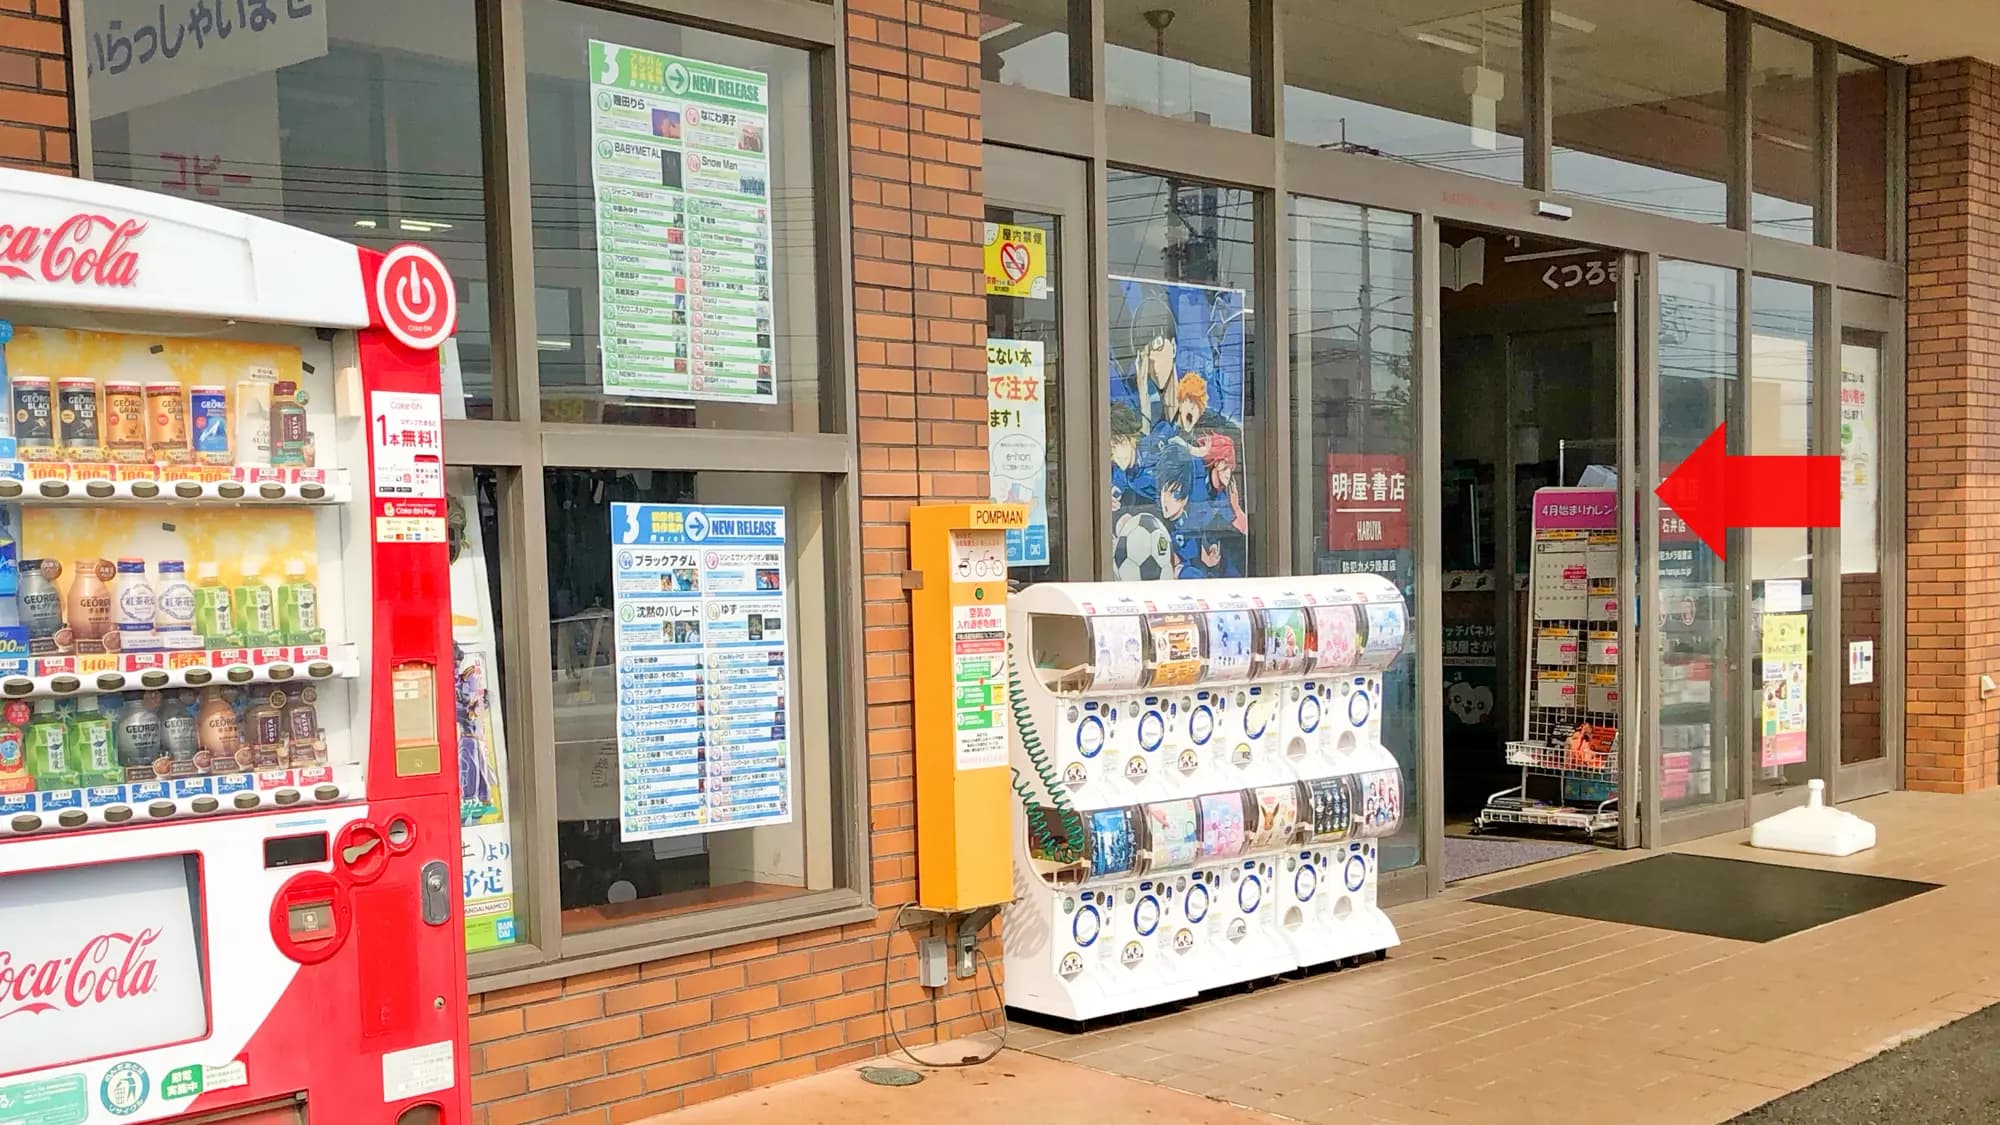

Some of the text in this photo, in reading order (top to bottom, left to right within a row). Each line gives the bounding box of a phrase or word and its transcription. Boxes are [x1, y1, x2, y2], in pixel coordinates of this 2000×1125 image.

[692, 74, 716, 95] NEW
[718, 77, 760, 103] RELEASE
[701, 110, 737, 127] なにわ男子
[614, 142, 661, 159] BABYMETAL
[702, 156, 738, 171] Snow Man
[160, 151, 252, 196] コピー
[1002, 229, 1042, 246] 屋内禁煙
[990, 375, 1039, 401] で注文
[1332, 472, 1406, 502] 明屋書店
[975, 509, 1023, 525] POMPMAN
[1542, 503, 1617, 517] 4月始まりカレン
[712, 519, 735, 536] NEW
[737, 520, 777, 536] RELEASE
[1357, 520, 1383, 541] HARUYA
[1661, 518, 1687, 533] 石井店
[635, 554, 697, 567] ブラックアダム
[1342, 560, 1397, 573] 防犯カメラ設置店
[636, 605, 699, 619] 沈黙のパレード
[721, 604, 737, 615] ゆず
[968, 607, 991, 618] 空気の
